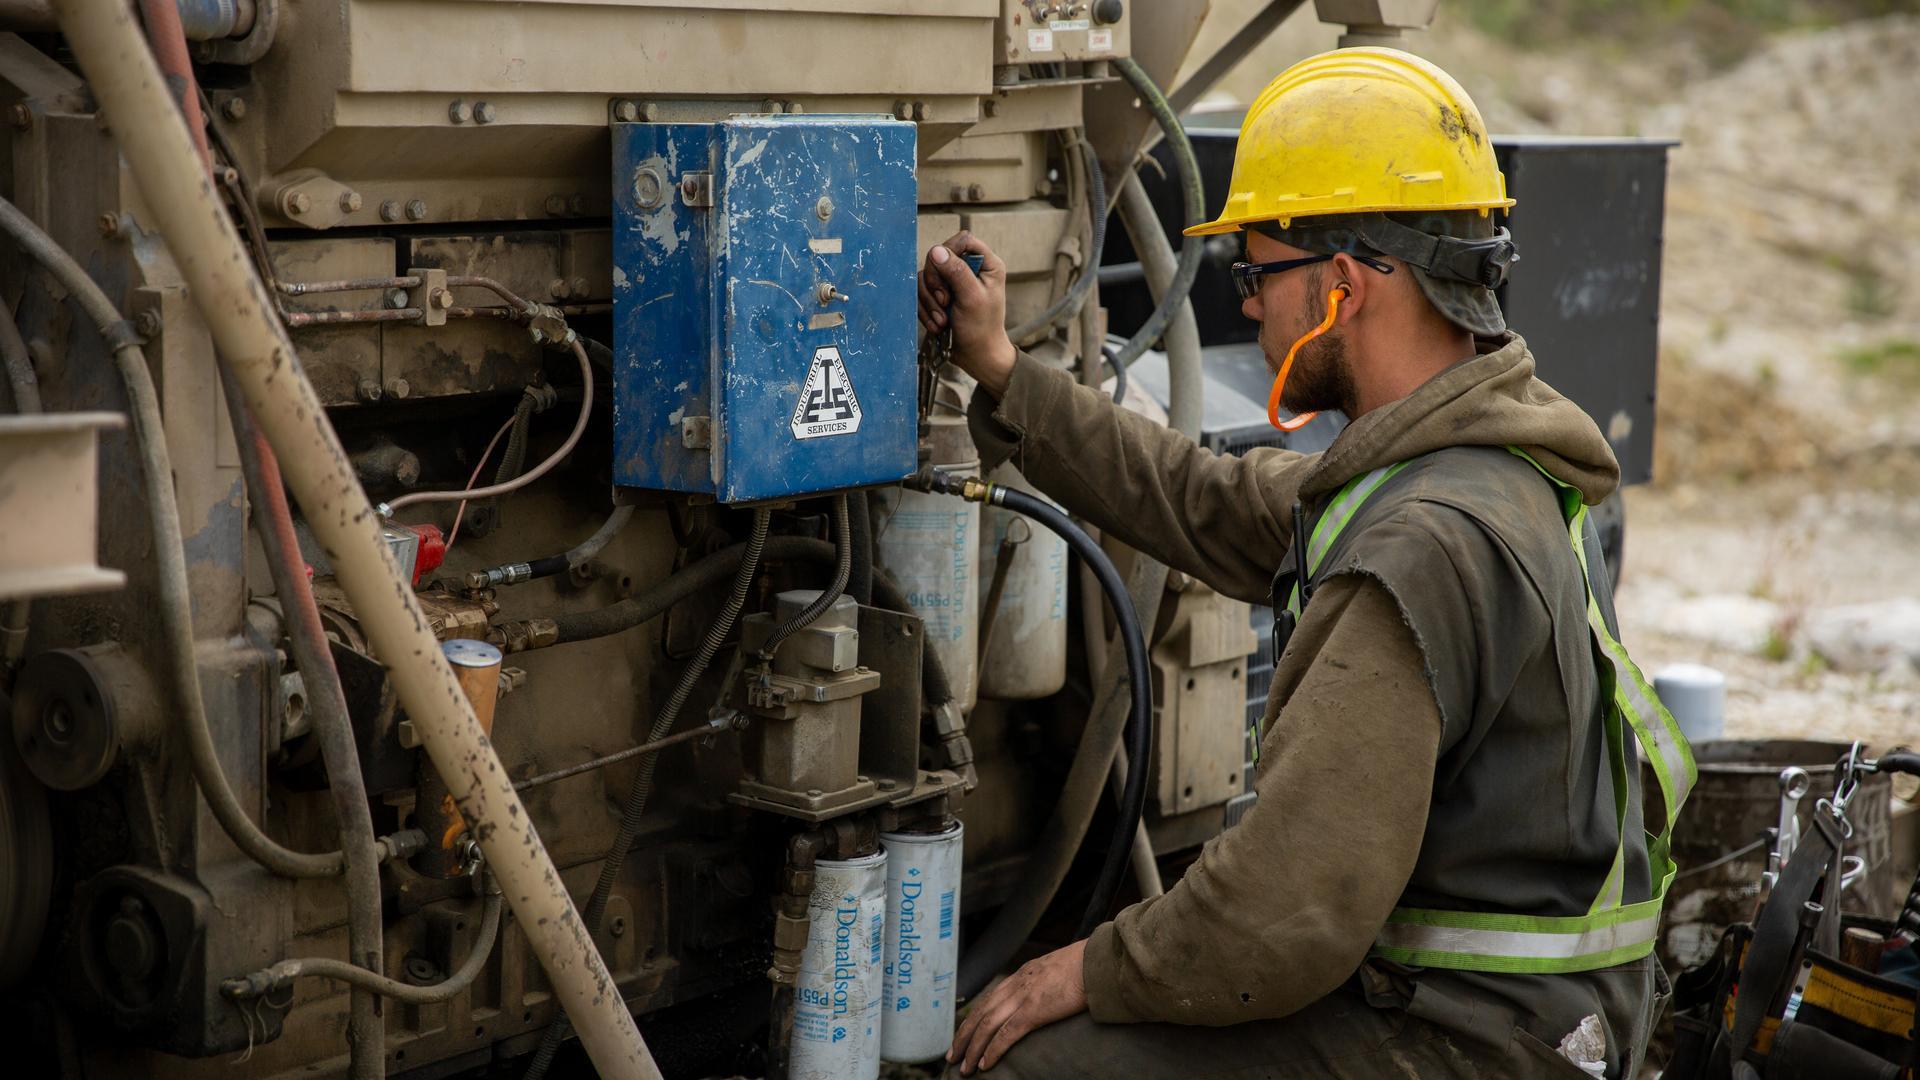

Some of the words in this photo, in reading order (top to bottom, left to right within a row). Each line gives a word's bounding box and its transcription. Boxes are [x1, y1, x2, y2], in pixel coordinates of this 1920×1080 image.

[793, 354, 822, 426] INDUSTRIAL
[807, 422, 847, 434] SERVICES
[834, 358, 859, 413] ELECTRIC
[953, 511, 969, 614] Donaldson
[832, 907, 858, 1014] Donaldson
[897, 881, 922, 986] Donaldson
